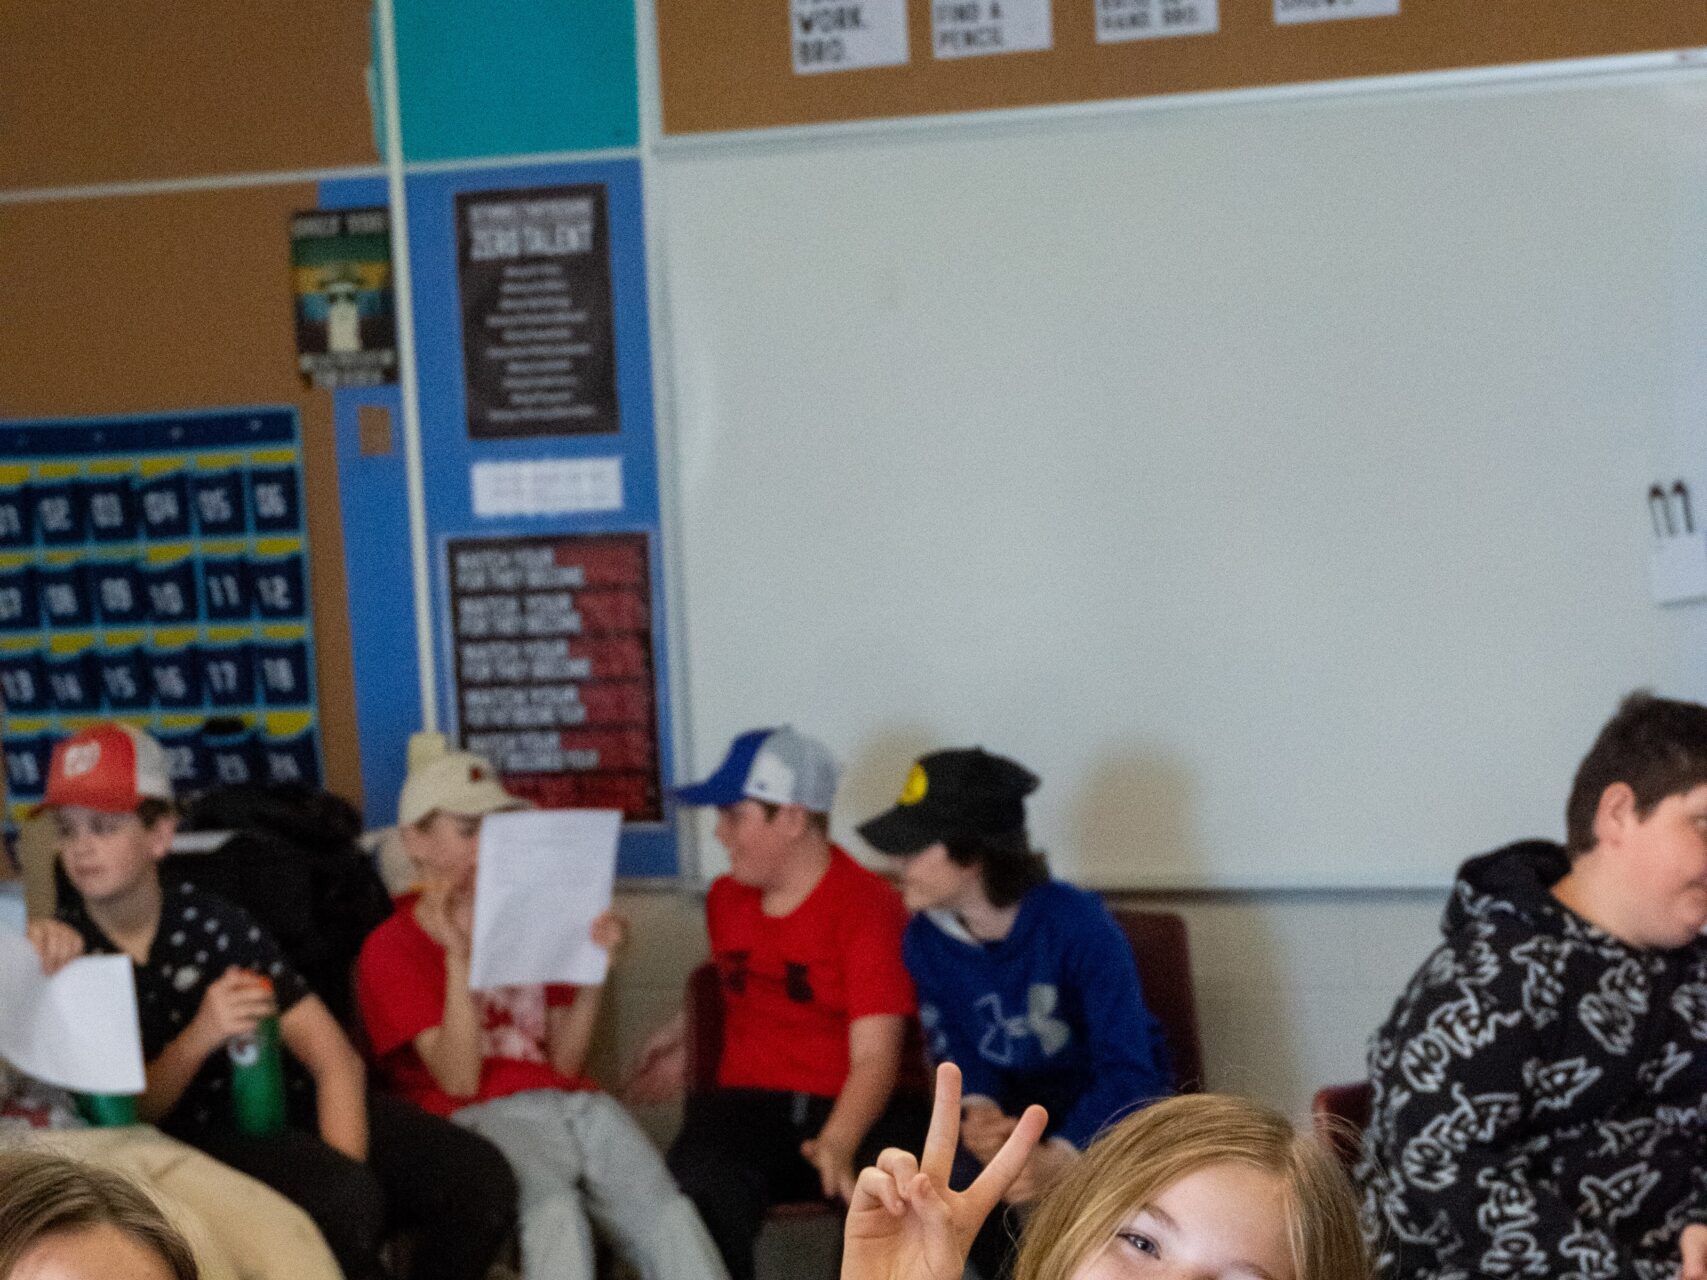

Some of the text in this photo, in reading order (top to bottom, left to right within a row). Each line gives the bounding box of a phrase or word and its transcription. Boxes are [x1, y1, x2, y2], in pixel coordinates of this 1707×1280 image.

[149, 581, 184, 614] 10
[206, 574, 239, 607] 11
[257, 575, 290, 609] 12
[2, 669, 35, 701] 13
[103, 665, 137, 698] 15
[153, 665, 187, 699] 16
[206, 659, 237, 693] 17
[263, 657, 295, 692] 18
